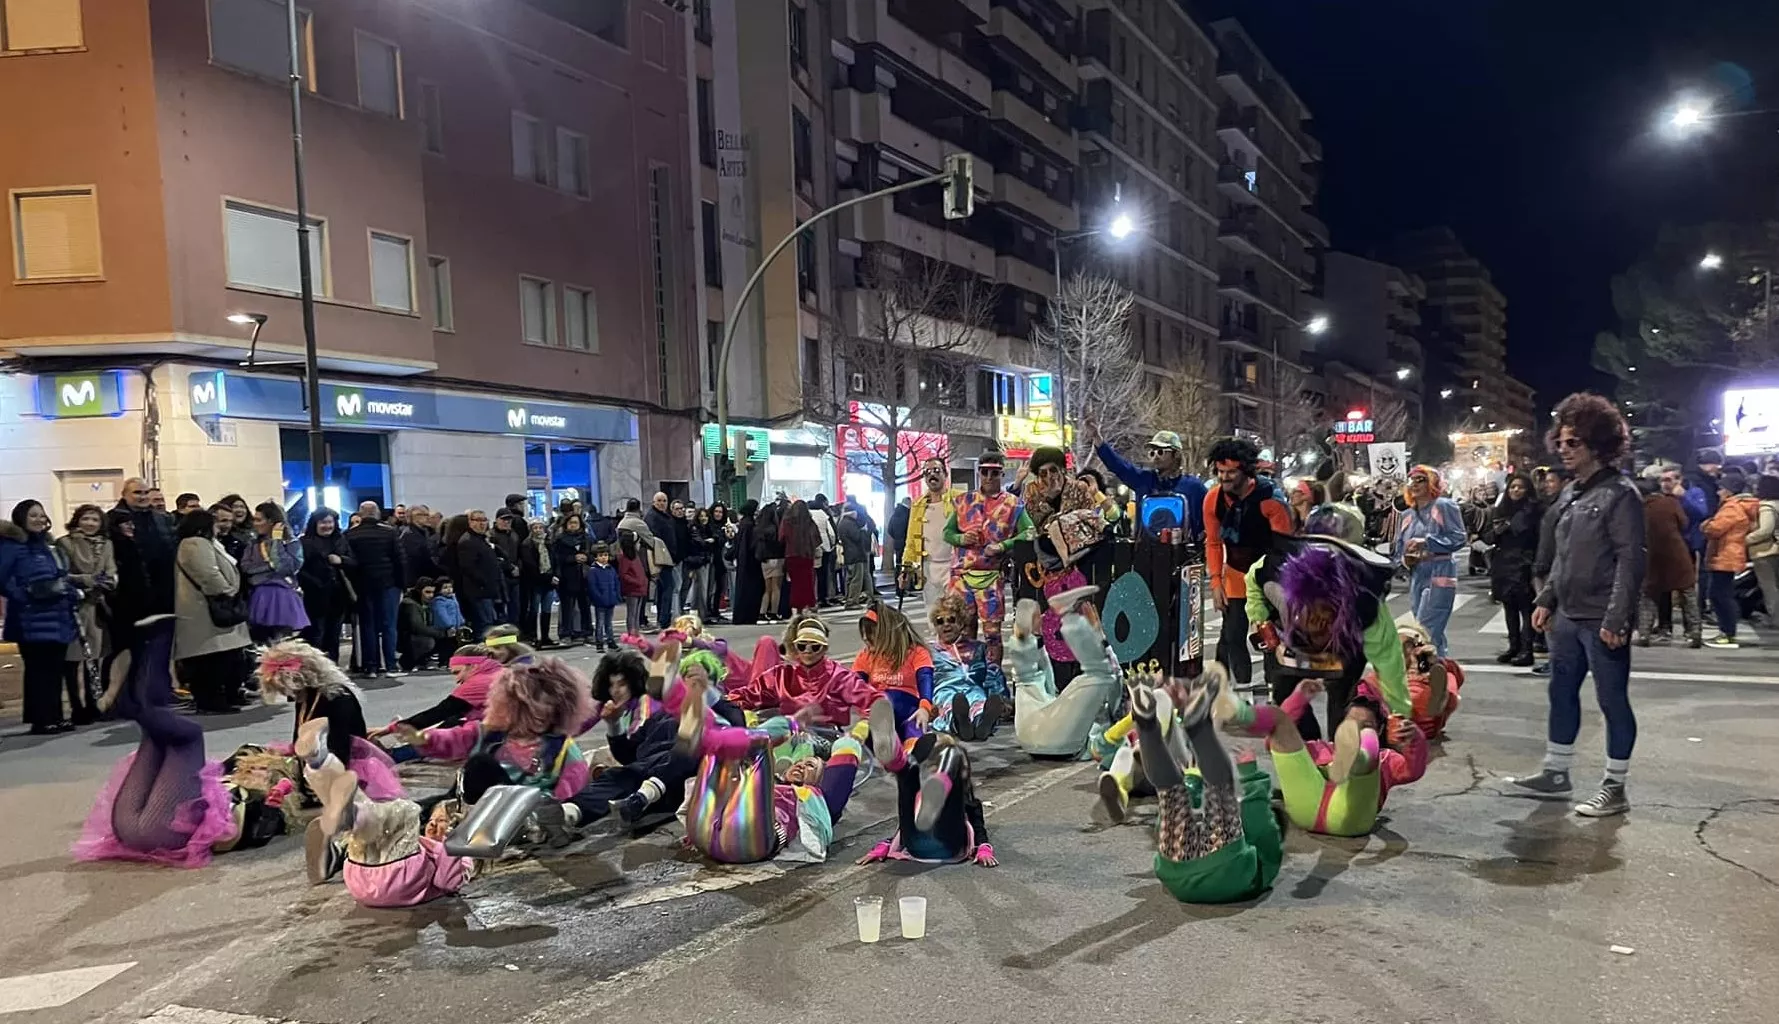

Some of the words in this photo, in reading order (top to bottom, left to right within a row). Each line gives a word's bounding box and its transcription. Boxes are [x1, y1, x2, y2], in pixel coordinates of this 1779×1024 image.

[367, 401, 413, 416] movistar
[530, 414, 566, 428] movistar
[1347, 420, 1374, 433] BAR
